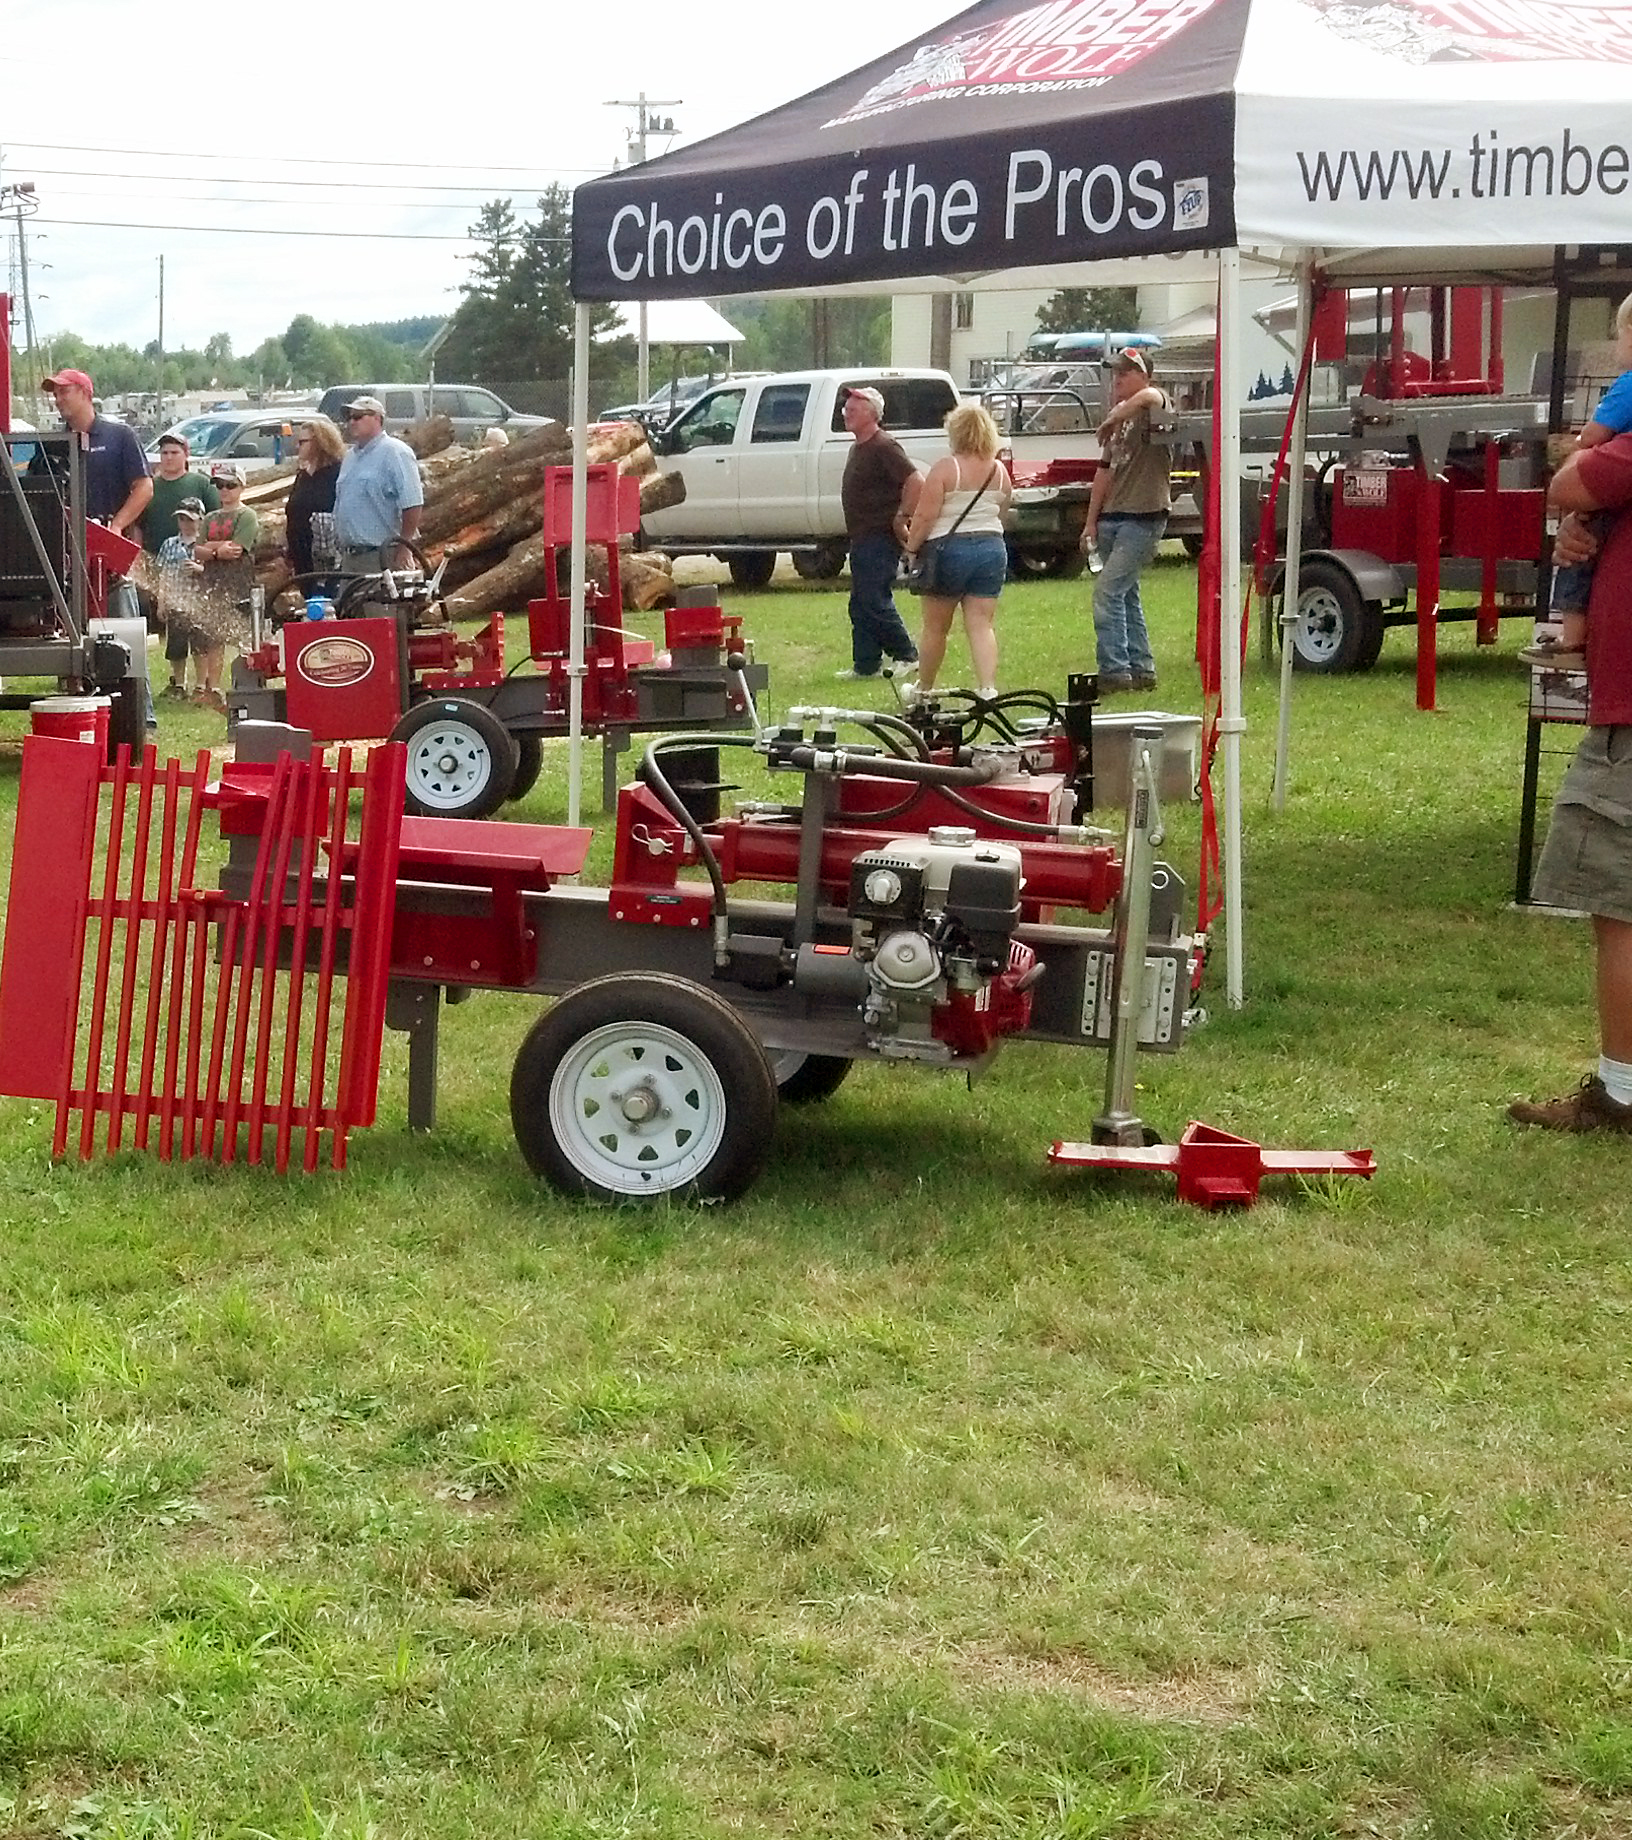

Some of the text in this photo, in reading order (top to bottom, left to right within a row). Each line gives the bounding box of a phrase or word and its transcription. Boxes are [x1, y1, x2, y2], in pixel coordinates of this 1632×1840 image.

[968, 0, 1215, 58] TIMBER
[964, 75, 1114, 97] CORPORATION
[967, 41, 1159, 81] WOLF
[1296, 127, 1630, 202] www.timbe
[606, 149, 1167, 282] Choice of the Pros
